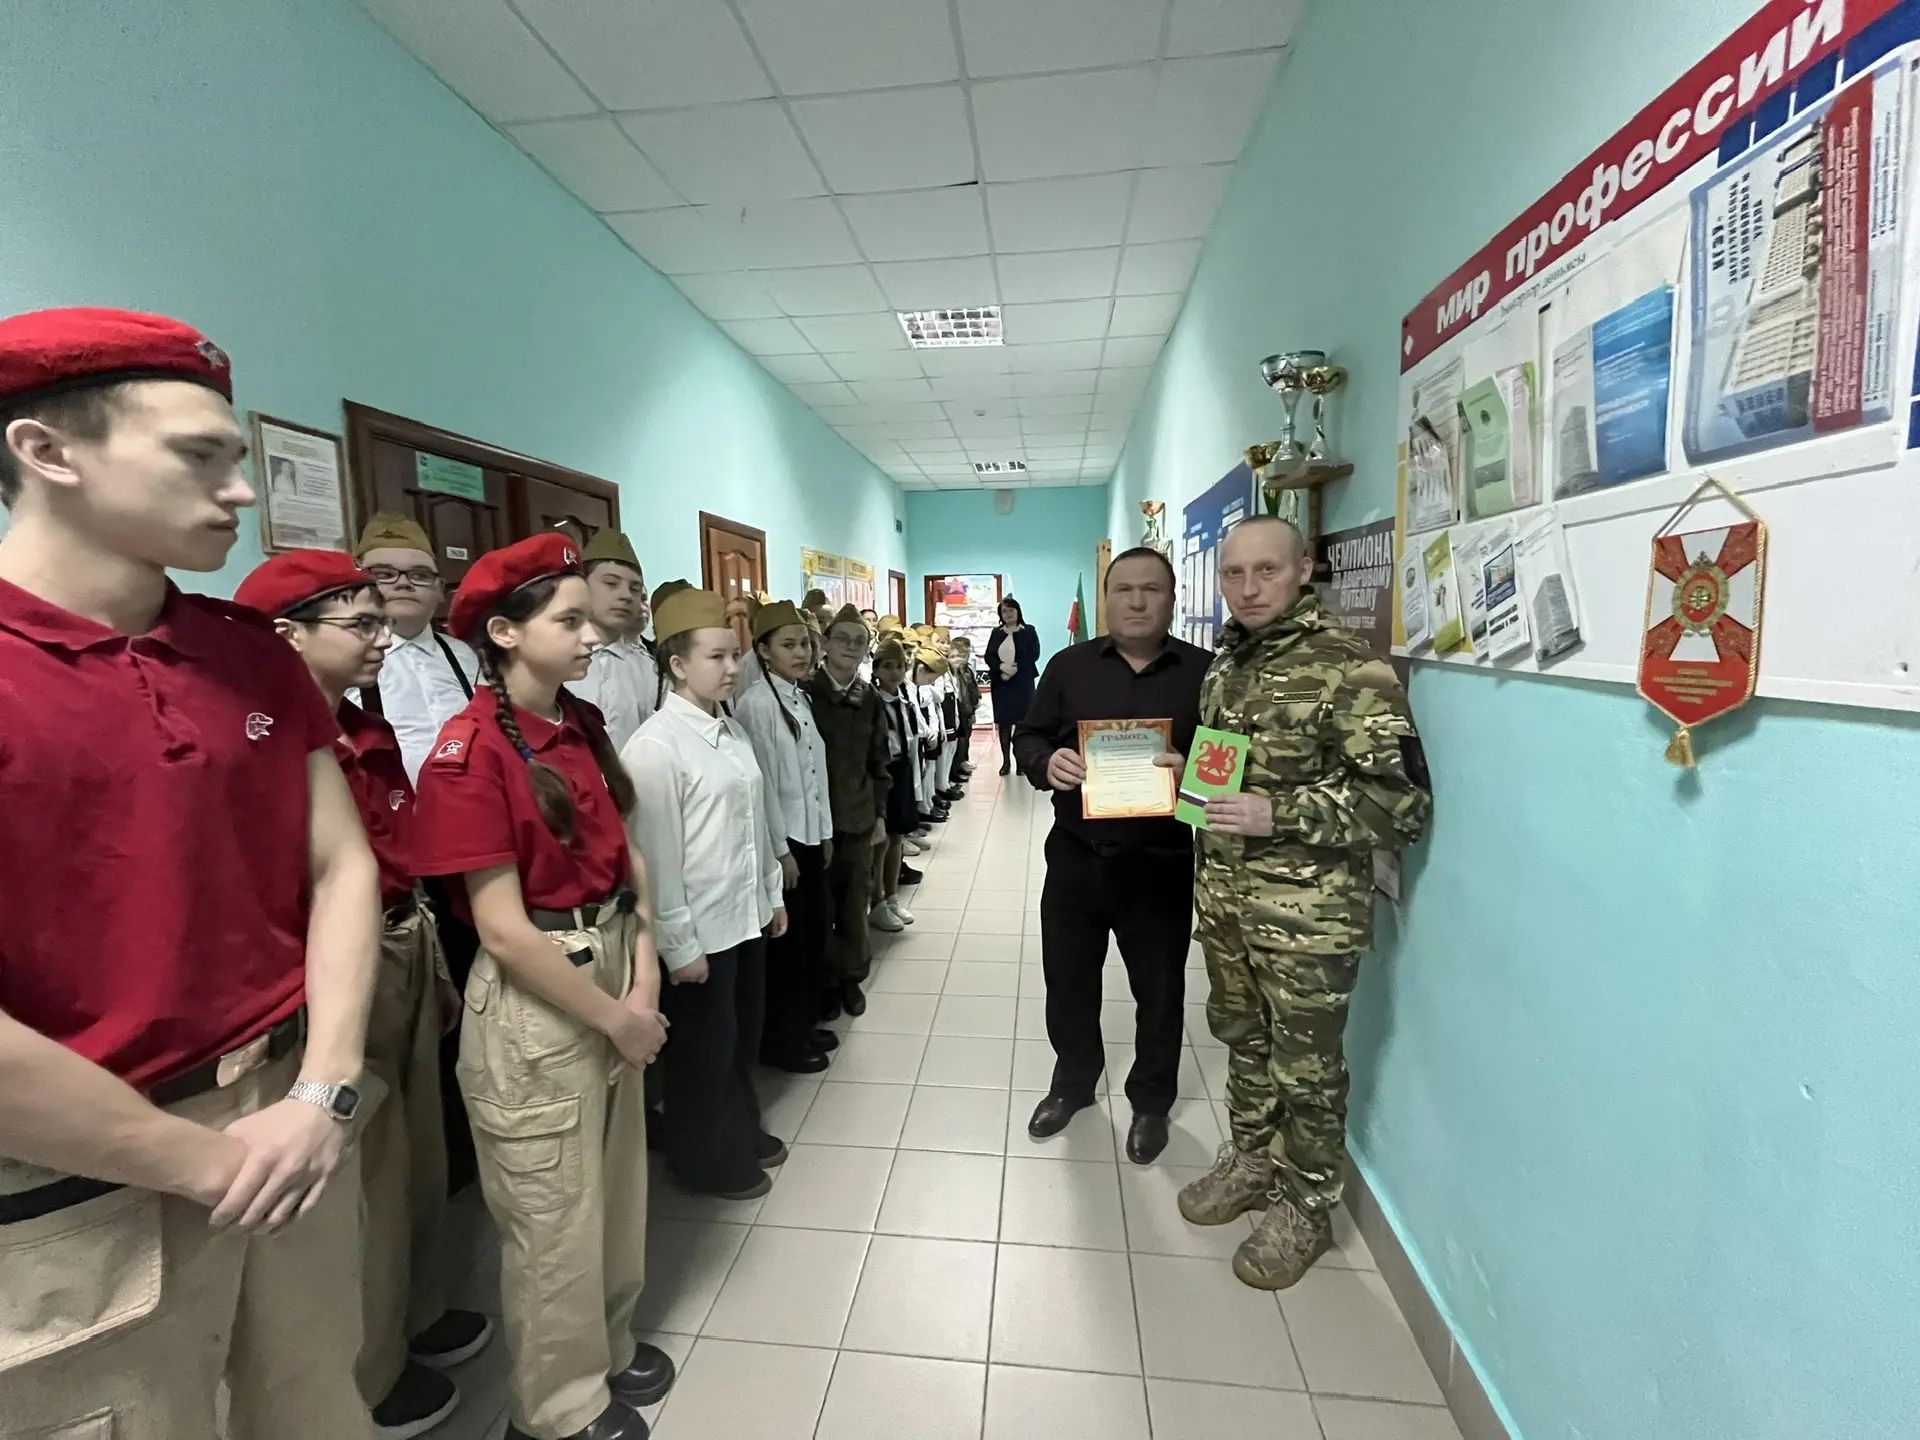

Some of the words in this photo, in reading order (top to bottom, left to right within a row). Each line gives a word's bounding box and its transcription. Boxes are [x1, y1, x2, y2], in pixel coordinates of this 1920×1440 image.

[1437, 270, 1490, 334] мир
[1505, 0, 1844, 281] профессий
[1101, 733, 1149, 742] ГРАМОТА
